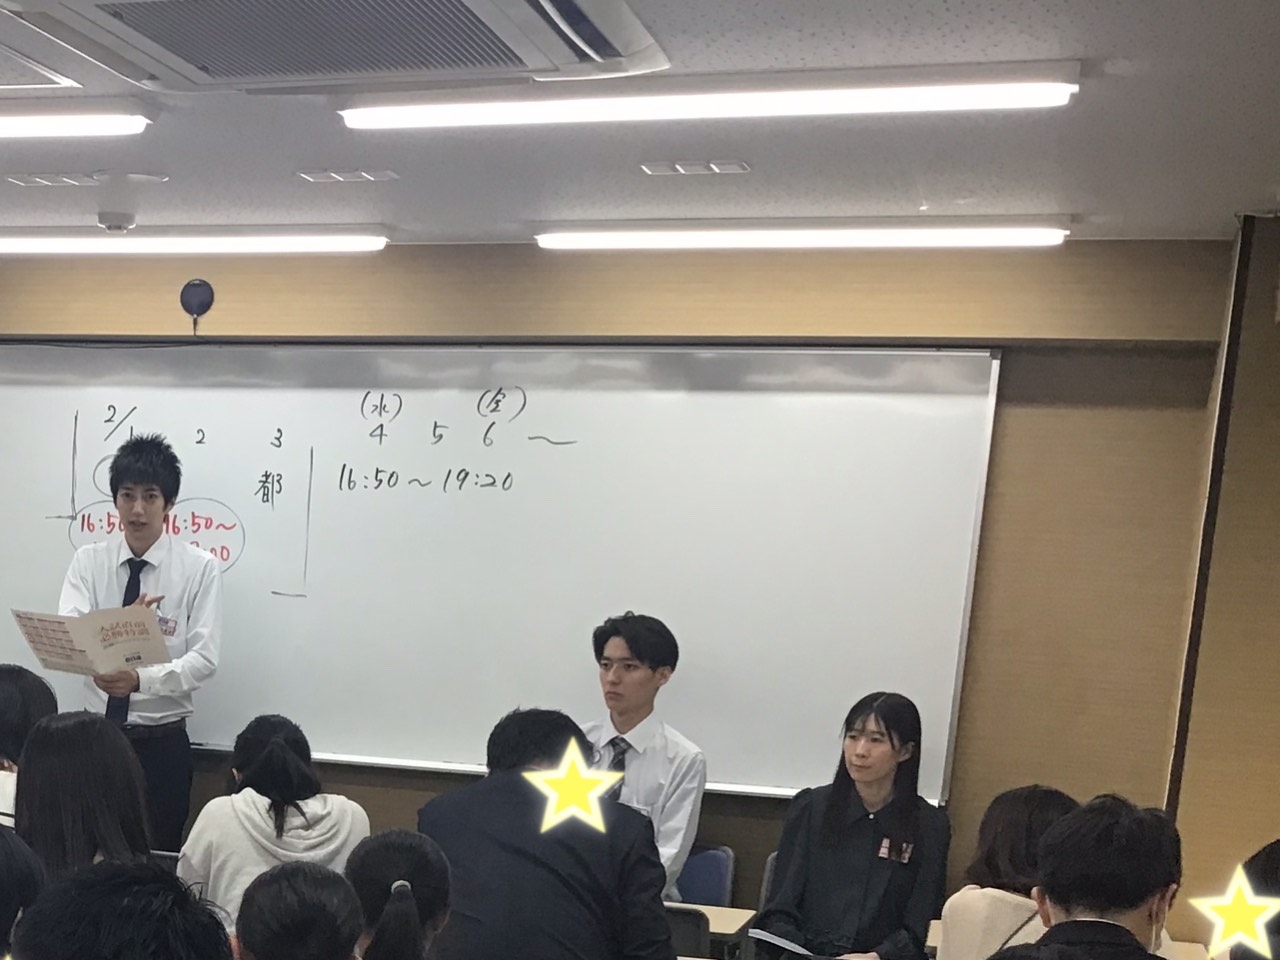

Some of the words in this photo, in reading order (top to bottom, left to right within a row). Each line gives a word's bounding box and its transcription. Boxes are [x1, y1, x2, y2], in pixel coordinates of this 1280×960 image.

[195, 428, 206, 444] 2
[270, 428, 283, 448] 3
[369, 423, 388, 446] 4
[430, 421, 449, 445] 5
[483, 421, 496, 447] 6
[254, 470, 283, 511] 都
